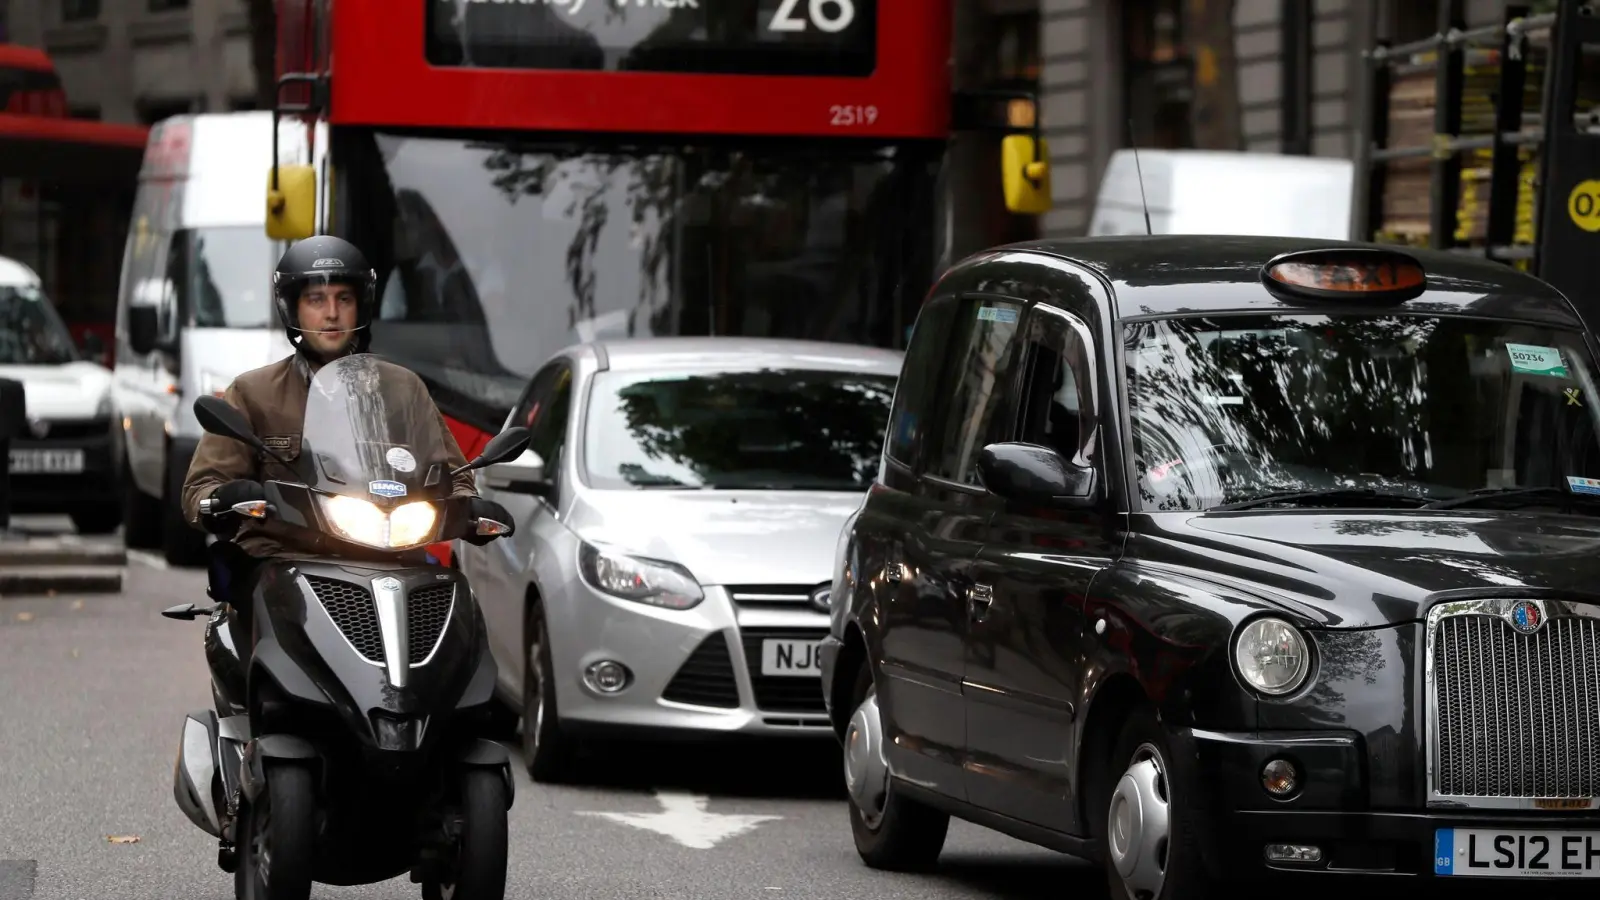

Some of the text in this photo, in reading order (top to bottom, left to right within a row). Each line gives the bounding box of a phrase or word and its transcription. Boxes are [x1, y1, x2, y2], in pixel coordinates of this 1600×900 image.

[829, 104, 878, 126] 2519
[1312, 262, 1398, 286] TAXI
[1512, 352, 1545, 362] 50236
[1437, 857, 1450, 867] GB
[1468, 834, 1549, 869] LS12
